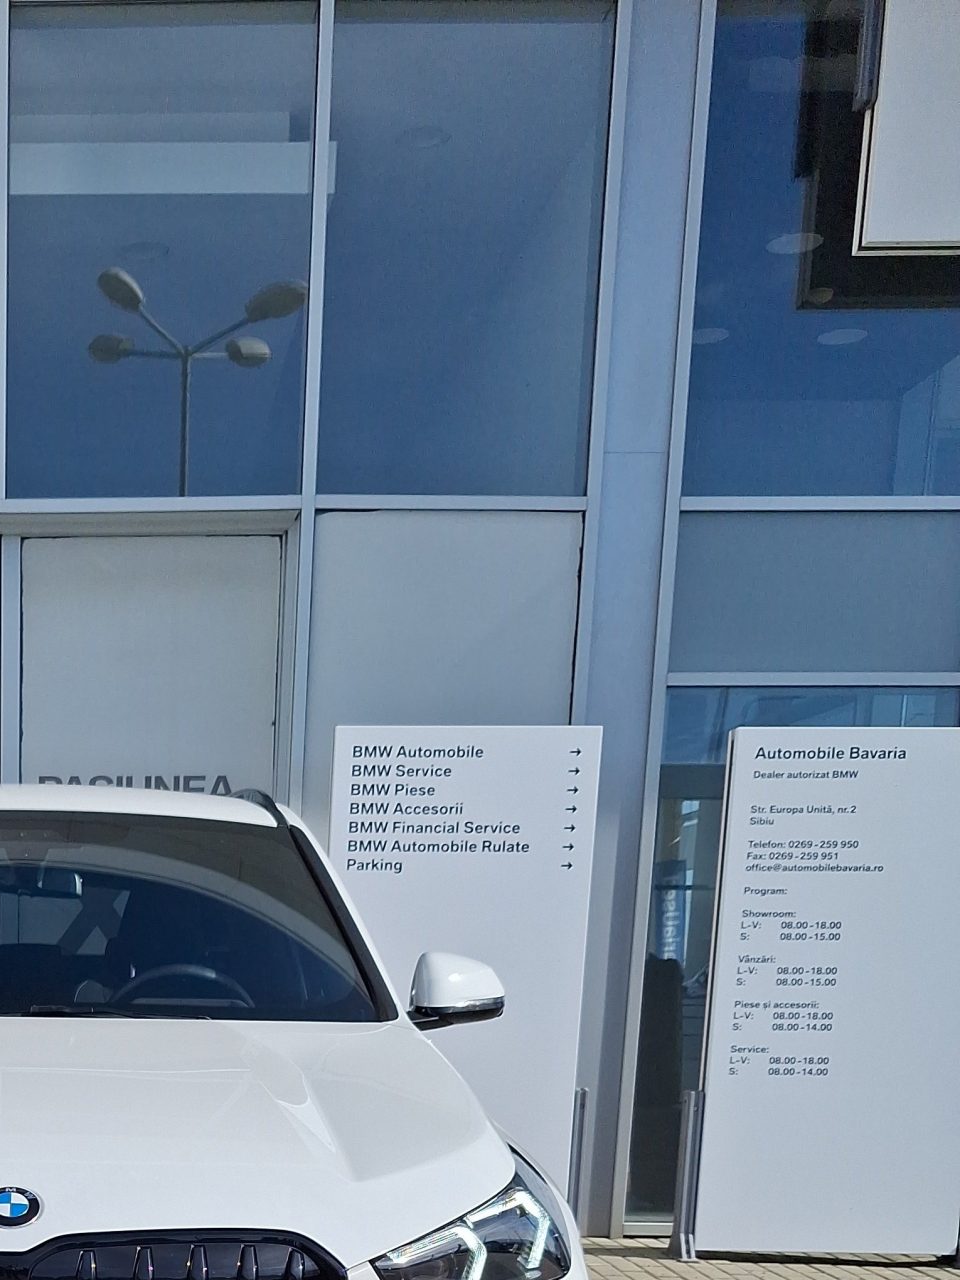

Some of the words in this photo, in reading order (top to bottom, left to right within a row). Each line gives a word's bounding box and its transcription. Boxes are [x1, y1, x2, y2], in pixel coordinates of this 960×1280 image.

[352, 746, 393, 758] BMW
[396, 745, 484, 758] Automobile
[755, 747, 845, 759] Automobile
[849, 746, 907, 759] Bavaria
[351, 765, 391, 777] BMW
[395, 764, 452, 777] Service
[753, 770, 785, 779] Dealer
[787, 770, 830, 779] autorizat
[832, 770, 858, 779] BMW
[350, 784, 390, 796] BMW
[394, 783, 436, 796] Piese
[349, 803, 389, 815] BMW
[393, 802, 463, 815] Accesorii
[750, 805, 766, 814] Str.
[770, 805, 804, 815] Europa
[750, 817, 774, 825] Sibiu
[348, 822, 388, 834] BMW
[392, 821, 459, 834] Financial
[464, 821, 520, 834] Service
[347, 840, 387, 853] BMW
[391, 840, 477, 853] Automobile
[482, 840, 529, 853] Rulate
[748, 840, 786, 849] Telefon:
[840, 840, 859, 849] 950
[747, 852, 766, 860] Fax:
[821, 852, 839, 860] 951
[346, 859, 403, 874] Parking
[745, 863, 884, 873] office@automobilebavaria.ro
[744, 887, 788, 896] Program:
[742, 910, 796, 918] Showroom:
[741, 921, 762, 929] L-V:
[740, 933, 750, 941] S:
[737, 967, 757, 975] L-V:
[736, 978, 746, 986] S:
[773, 1001, 819, 1009] accesorii:
[733, 1012, 754, 1020] L-V:
[732, 1023, 742, 1031] S:
[730, 1045, 769, 1054] Service:
[730, 1056, 750, 1064] L-V:
[729, 1068, 738, 1076] S:
